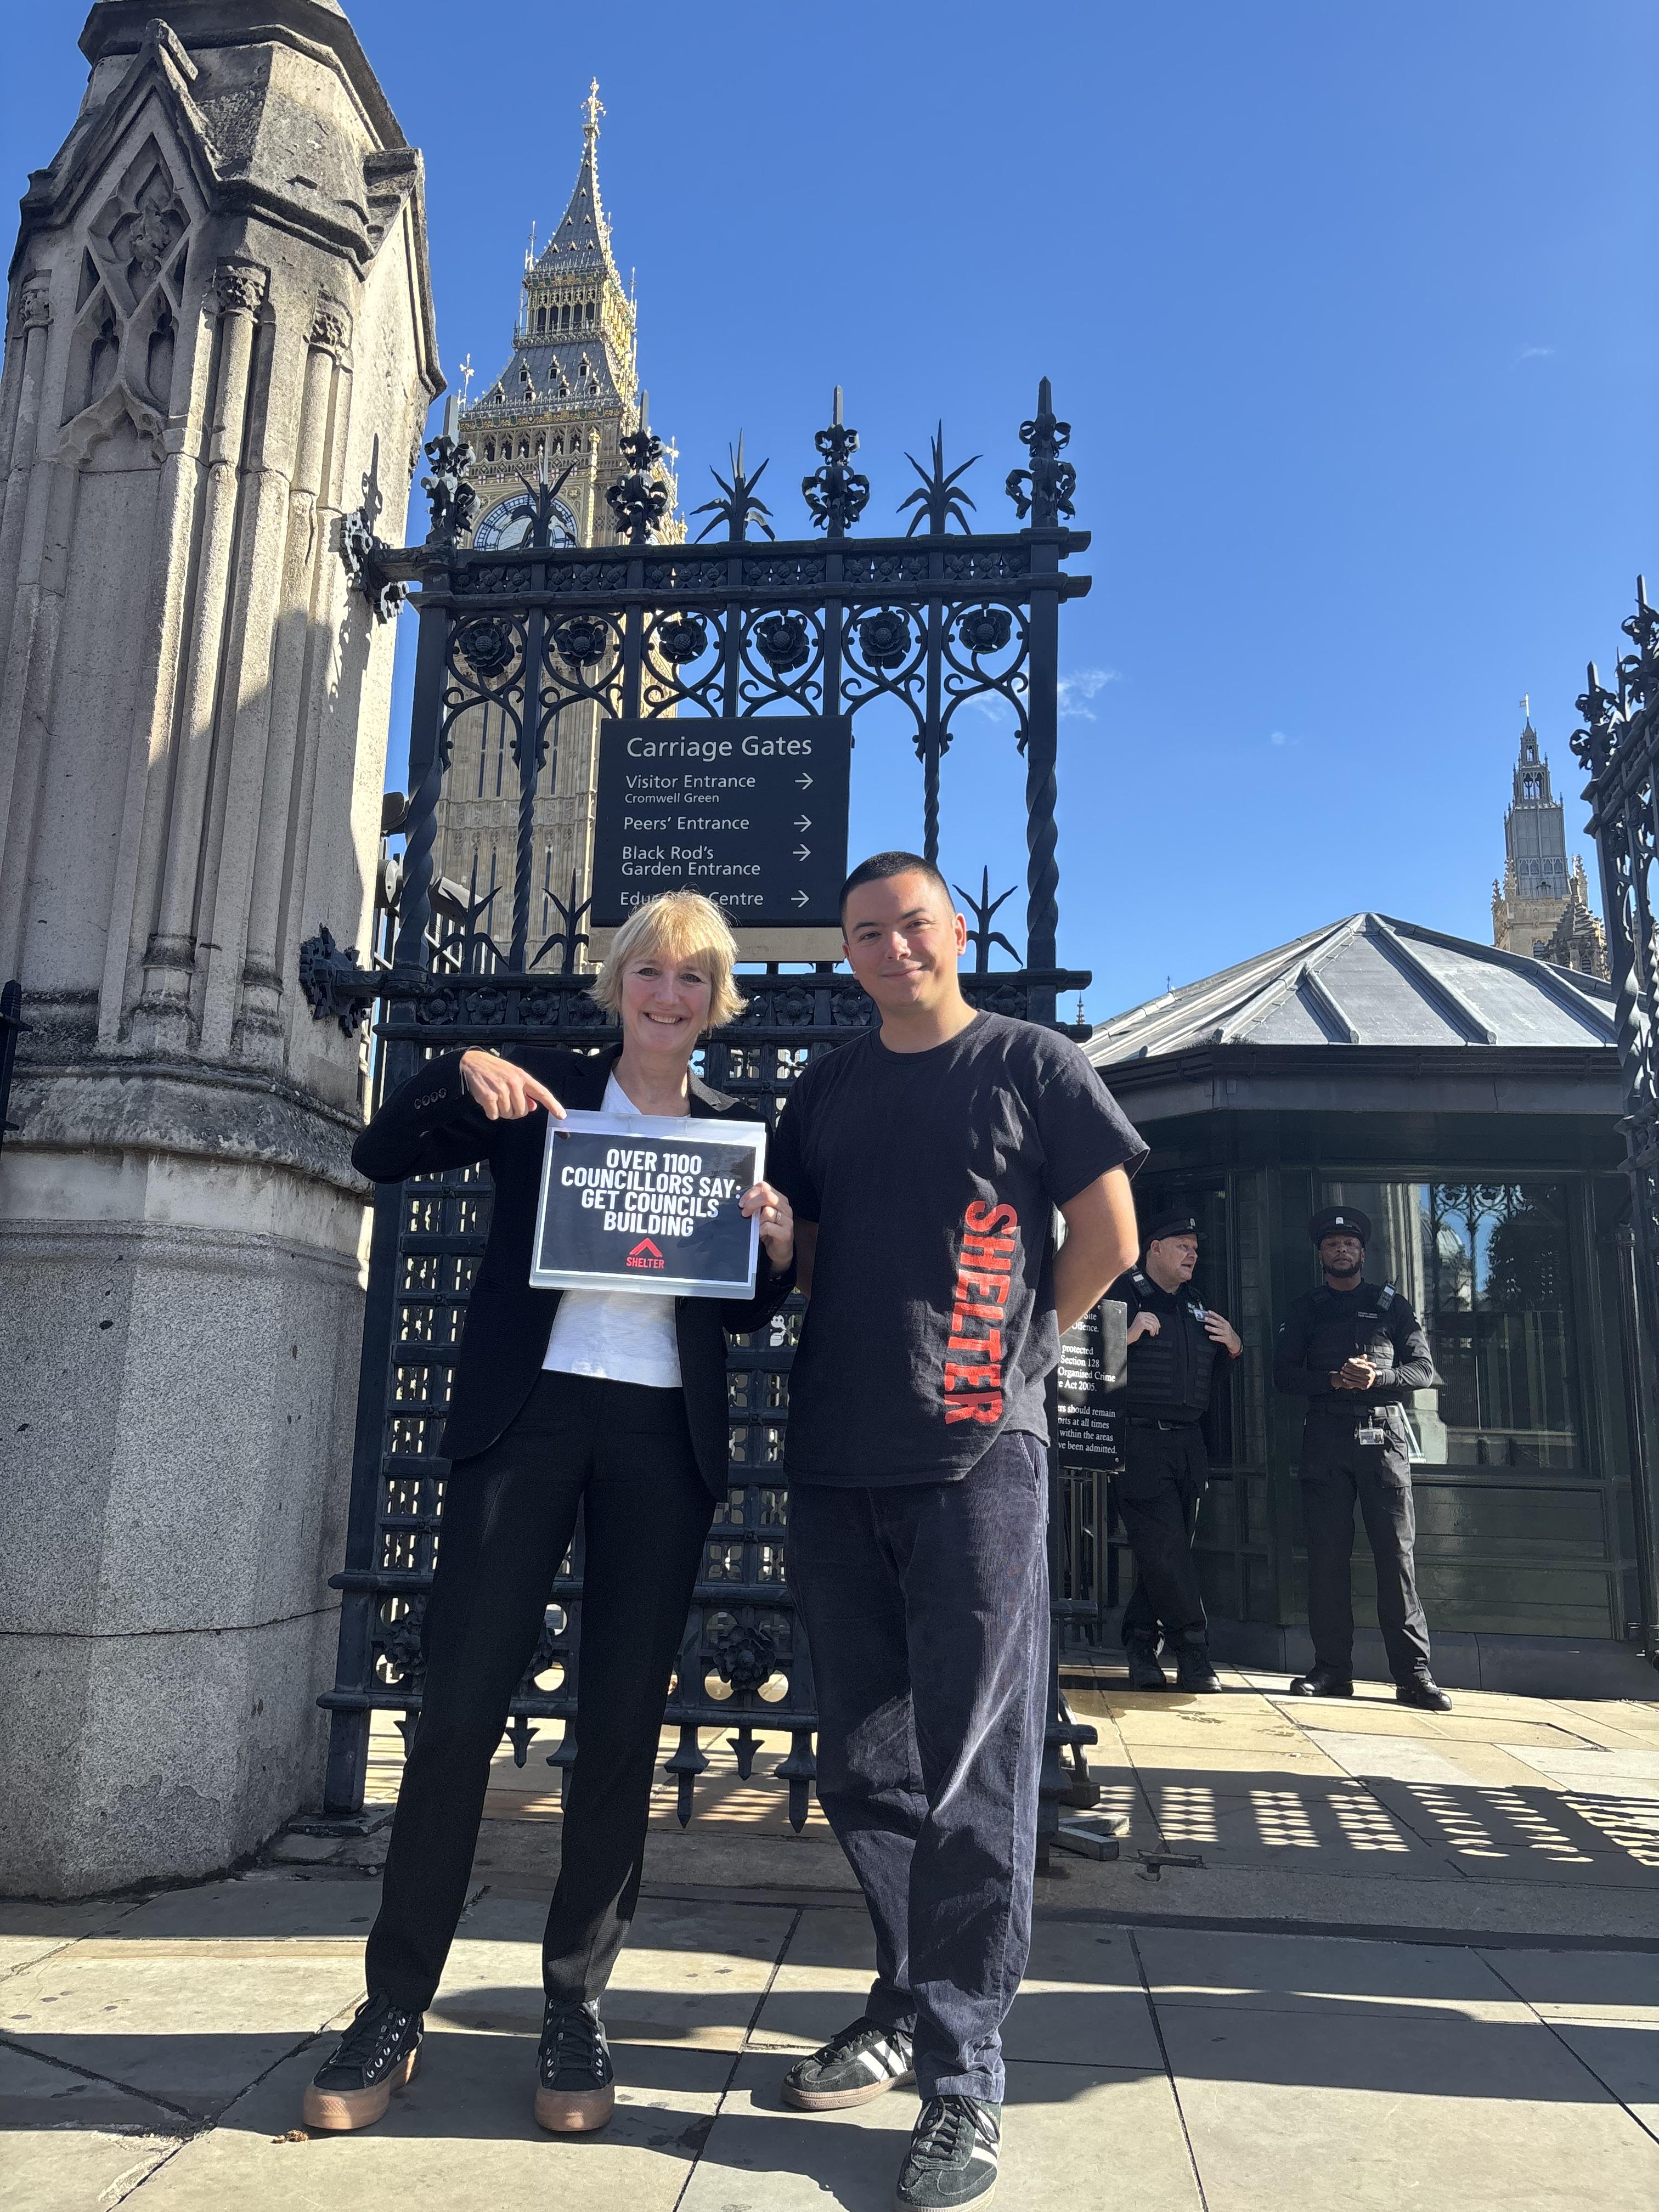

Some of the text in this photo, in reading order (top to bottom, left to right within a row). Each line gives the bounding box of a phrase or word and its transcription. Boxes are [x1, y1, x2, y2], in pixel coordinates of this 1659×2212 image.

[627, 736, 812, 762] Carriage Gates
[625, 774, 756, 788] Visitor Entrance
[625, 792, 719, 803] Cromwell Green
[624, 816, 749, 830] Peers’ Entrance
[623, 845, 714, 860] Black Rod’s
[622, 861, 761, 876] Garden Entrance
[708, 891, 764, 906] Centre
[606, 1148, 702, 1175] OVER 1100
[561, 1166, 741, 1199] COUNCILLORS SAY:
[581, 1188, 719, 1218] GET COUNCILS
[603, 1211, 693, 1237] BUILDING
[626, 1255, 665, 1269] SHELTER
[944, 1200, 1018, 1425] SHELTER
[1062, 1345, 1093, 1355] protected
[1060, 1355, 1100, 1368] Section 128
[1058, 1367, 1116, 1382] Organised Crime
[1064, 1379, 1077, 1390] Act
[1079, 1381, 1097, 1392] 2005.
[1067, 1404, 1091, 1415] should
[1092, 1409, 1115, 1418] remain
[1080, 1418, 1090, 1427] all
[1091, 1419, 1109, 1429] times
[1059, 1427, 1114, 1442] within the areas
[1067, 1440, 1084, 1451] been
[1085, 1443, 1118, 1454] admitted.
